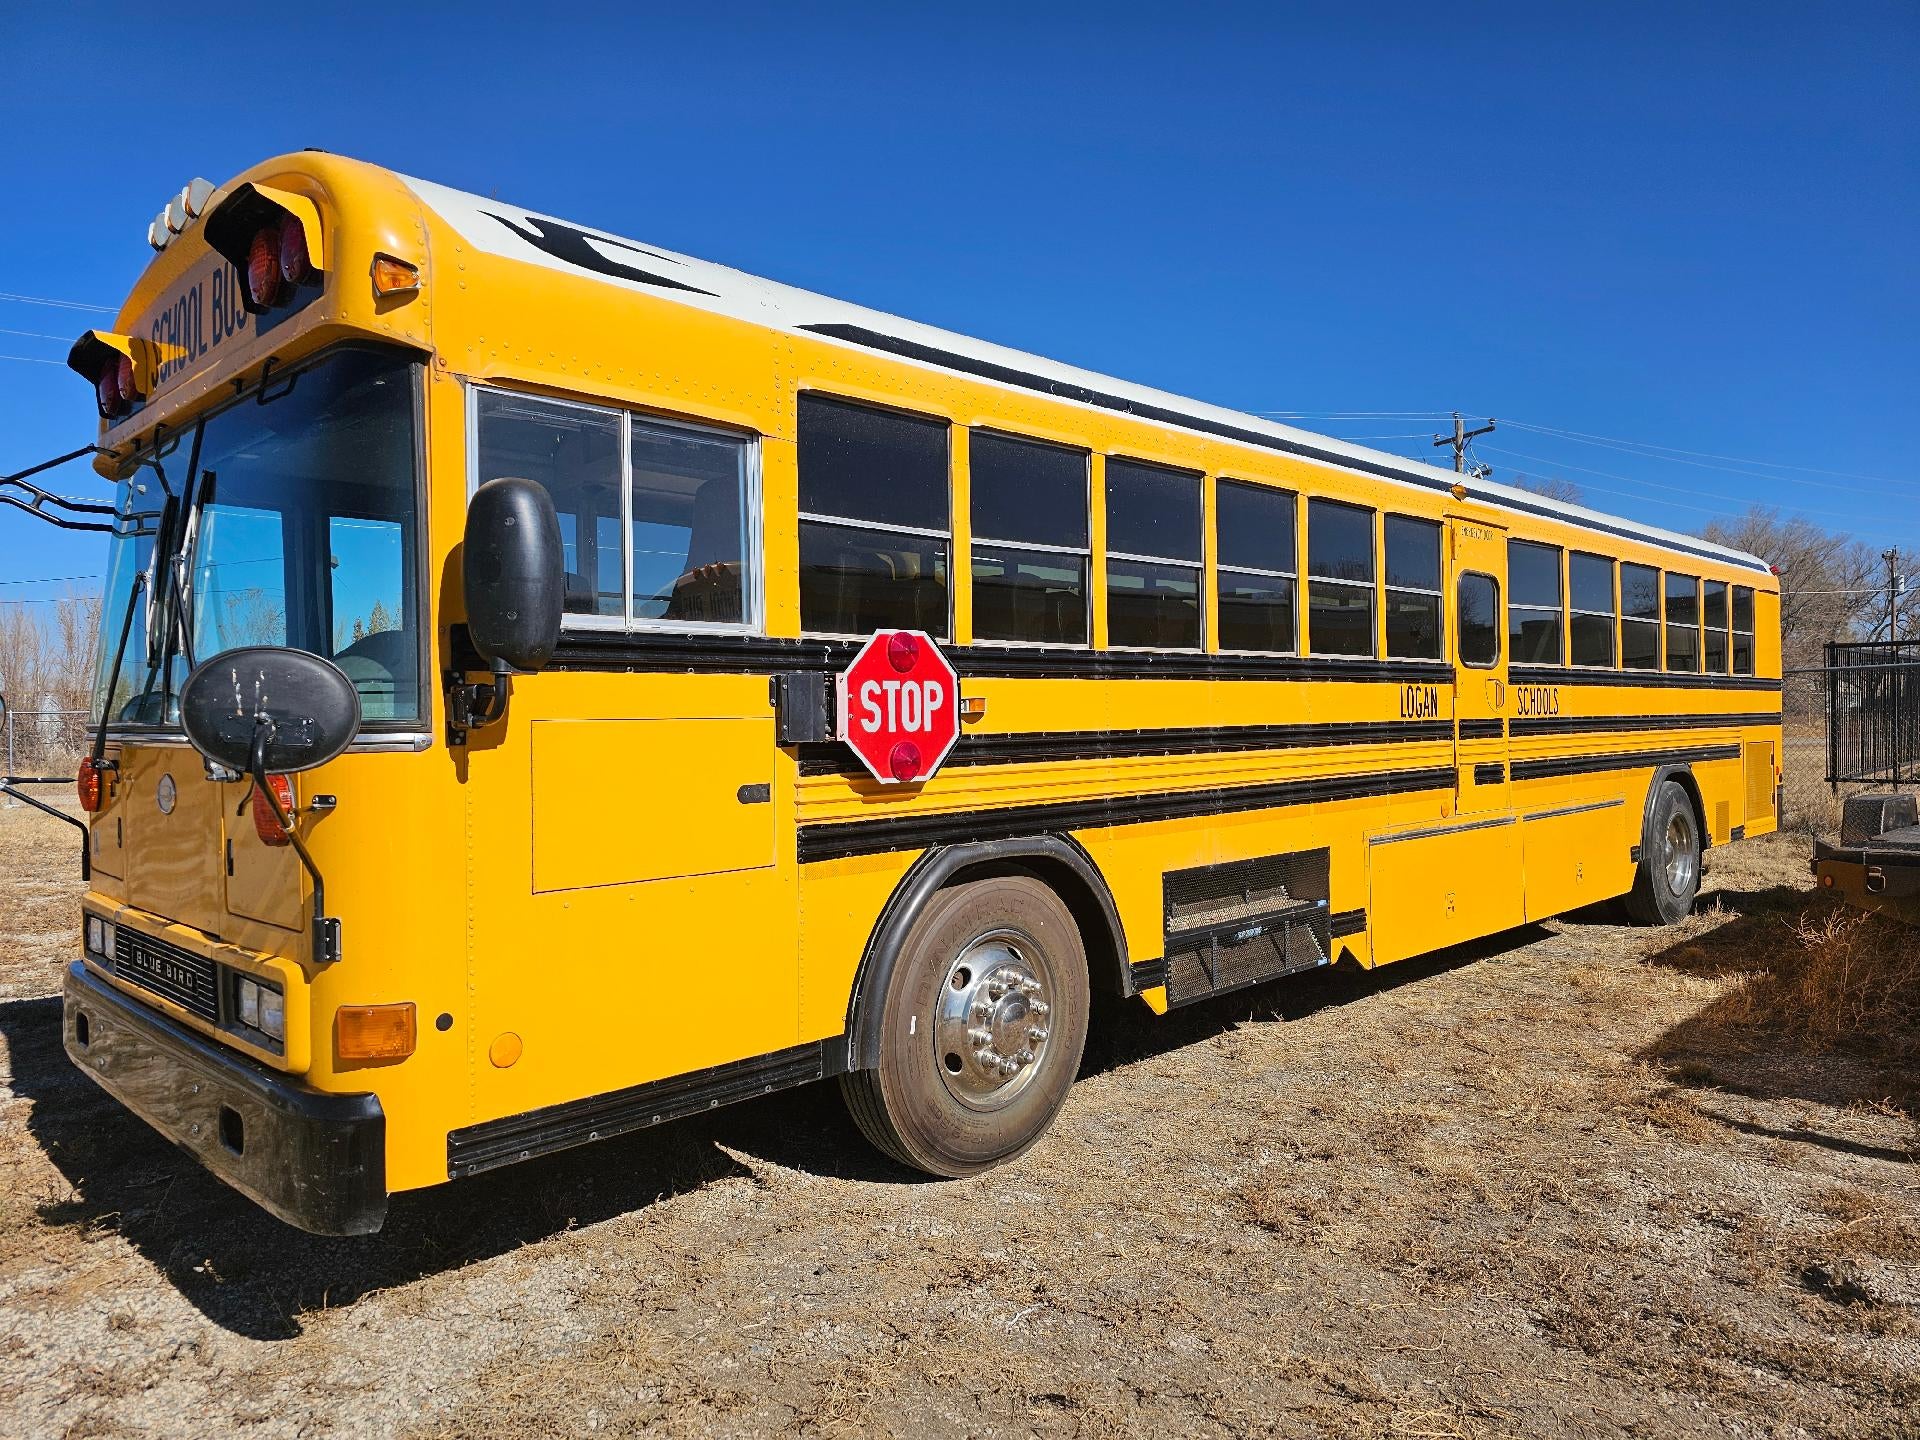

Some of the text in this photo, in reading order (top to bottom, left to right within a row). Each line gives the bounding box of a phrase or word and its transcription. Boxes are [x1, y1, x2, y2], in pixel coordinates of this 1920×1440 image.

[151, 282, 207, 391] SCHOOL
[860, 680, 944, 733] STOP
[1400, 685, 1559, 718] LOGAN SCHOOLS
[136, 950, 193, 988] BLUE BIRD
